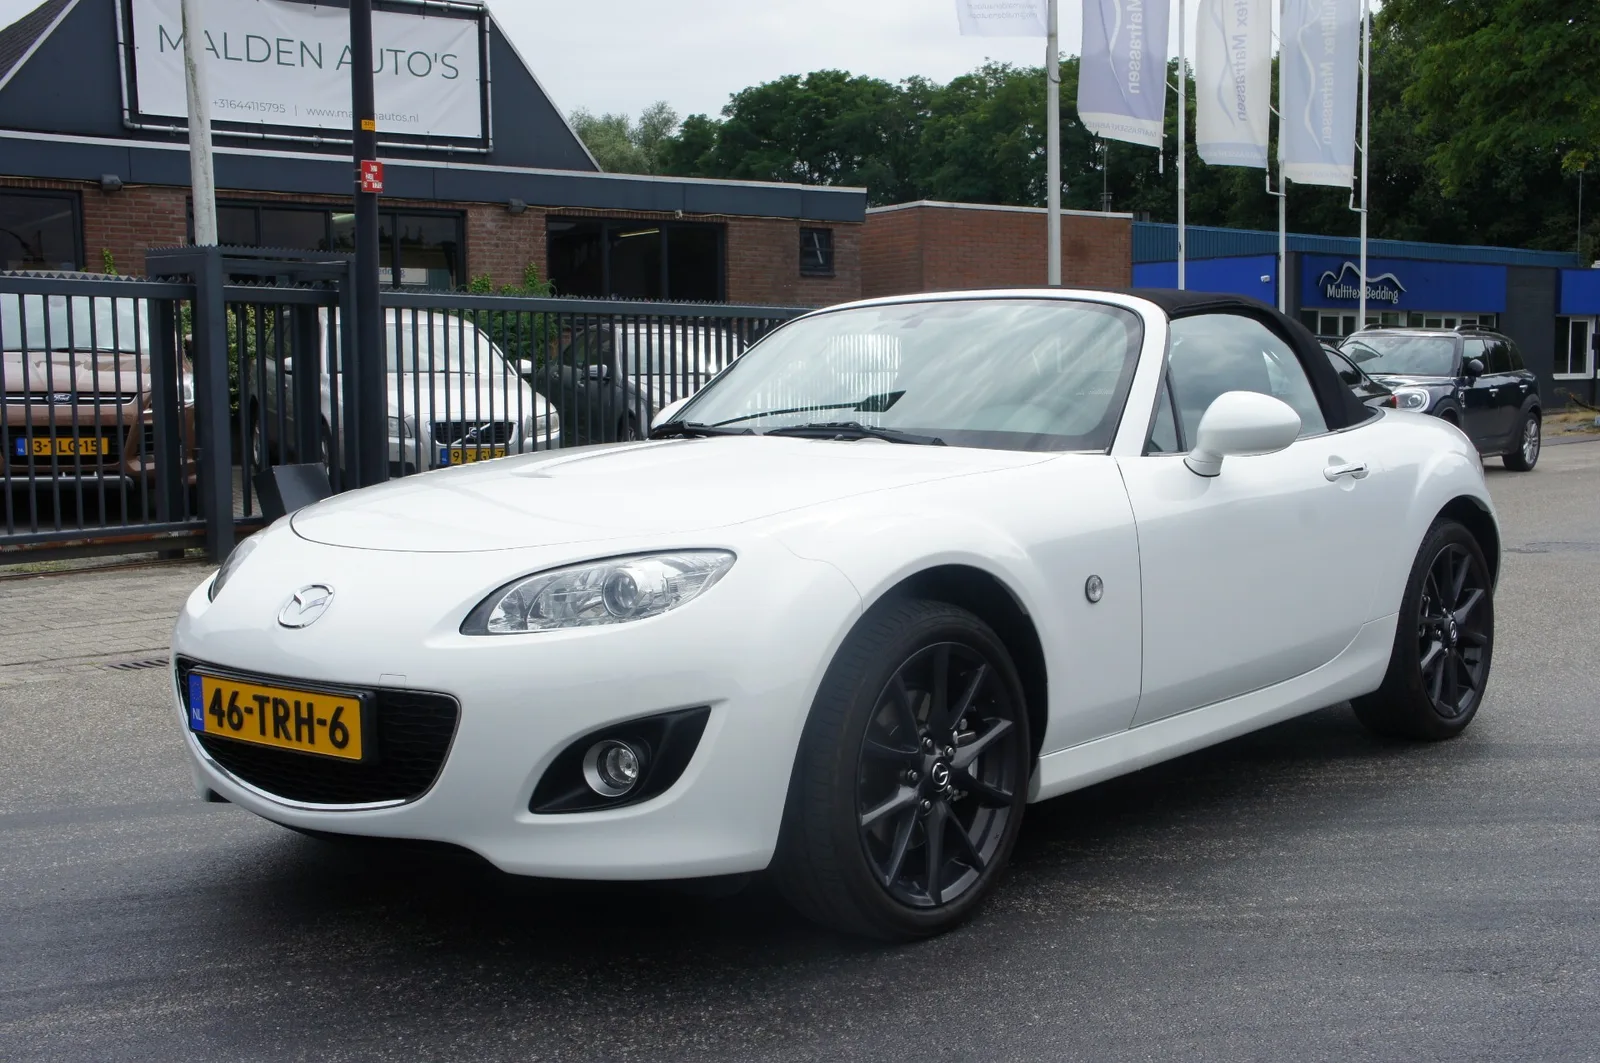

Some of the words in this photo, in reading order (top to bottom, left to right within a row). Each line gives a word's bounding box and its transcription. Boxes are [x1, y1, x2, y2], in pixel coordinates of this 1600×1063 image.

[159, 24, 323, 69] MALDEN
[212, 98, 286, 114] +31644115795
[306, 107, 419, 123] www.manautos.nl
[1365, 285, 1399, 304] Bedding
[192, 707, 203, 721] NL
[208, 687, 350, 750] 46-TRH-6
